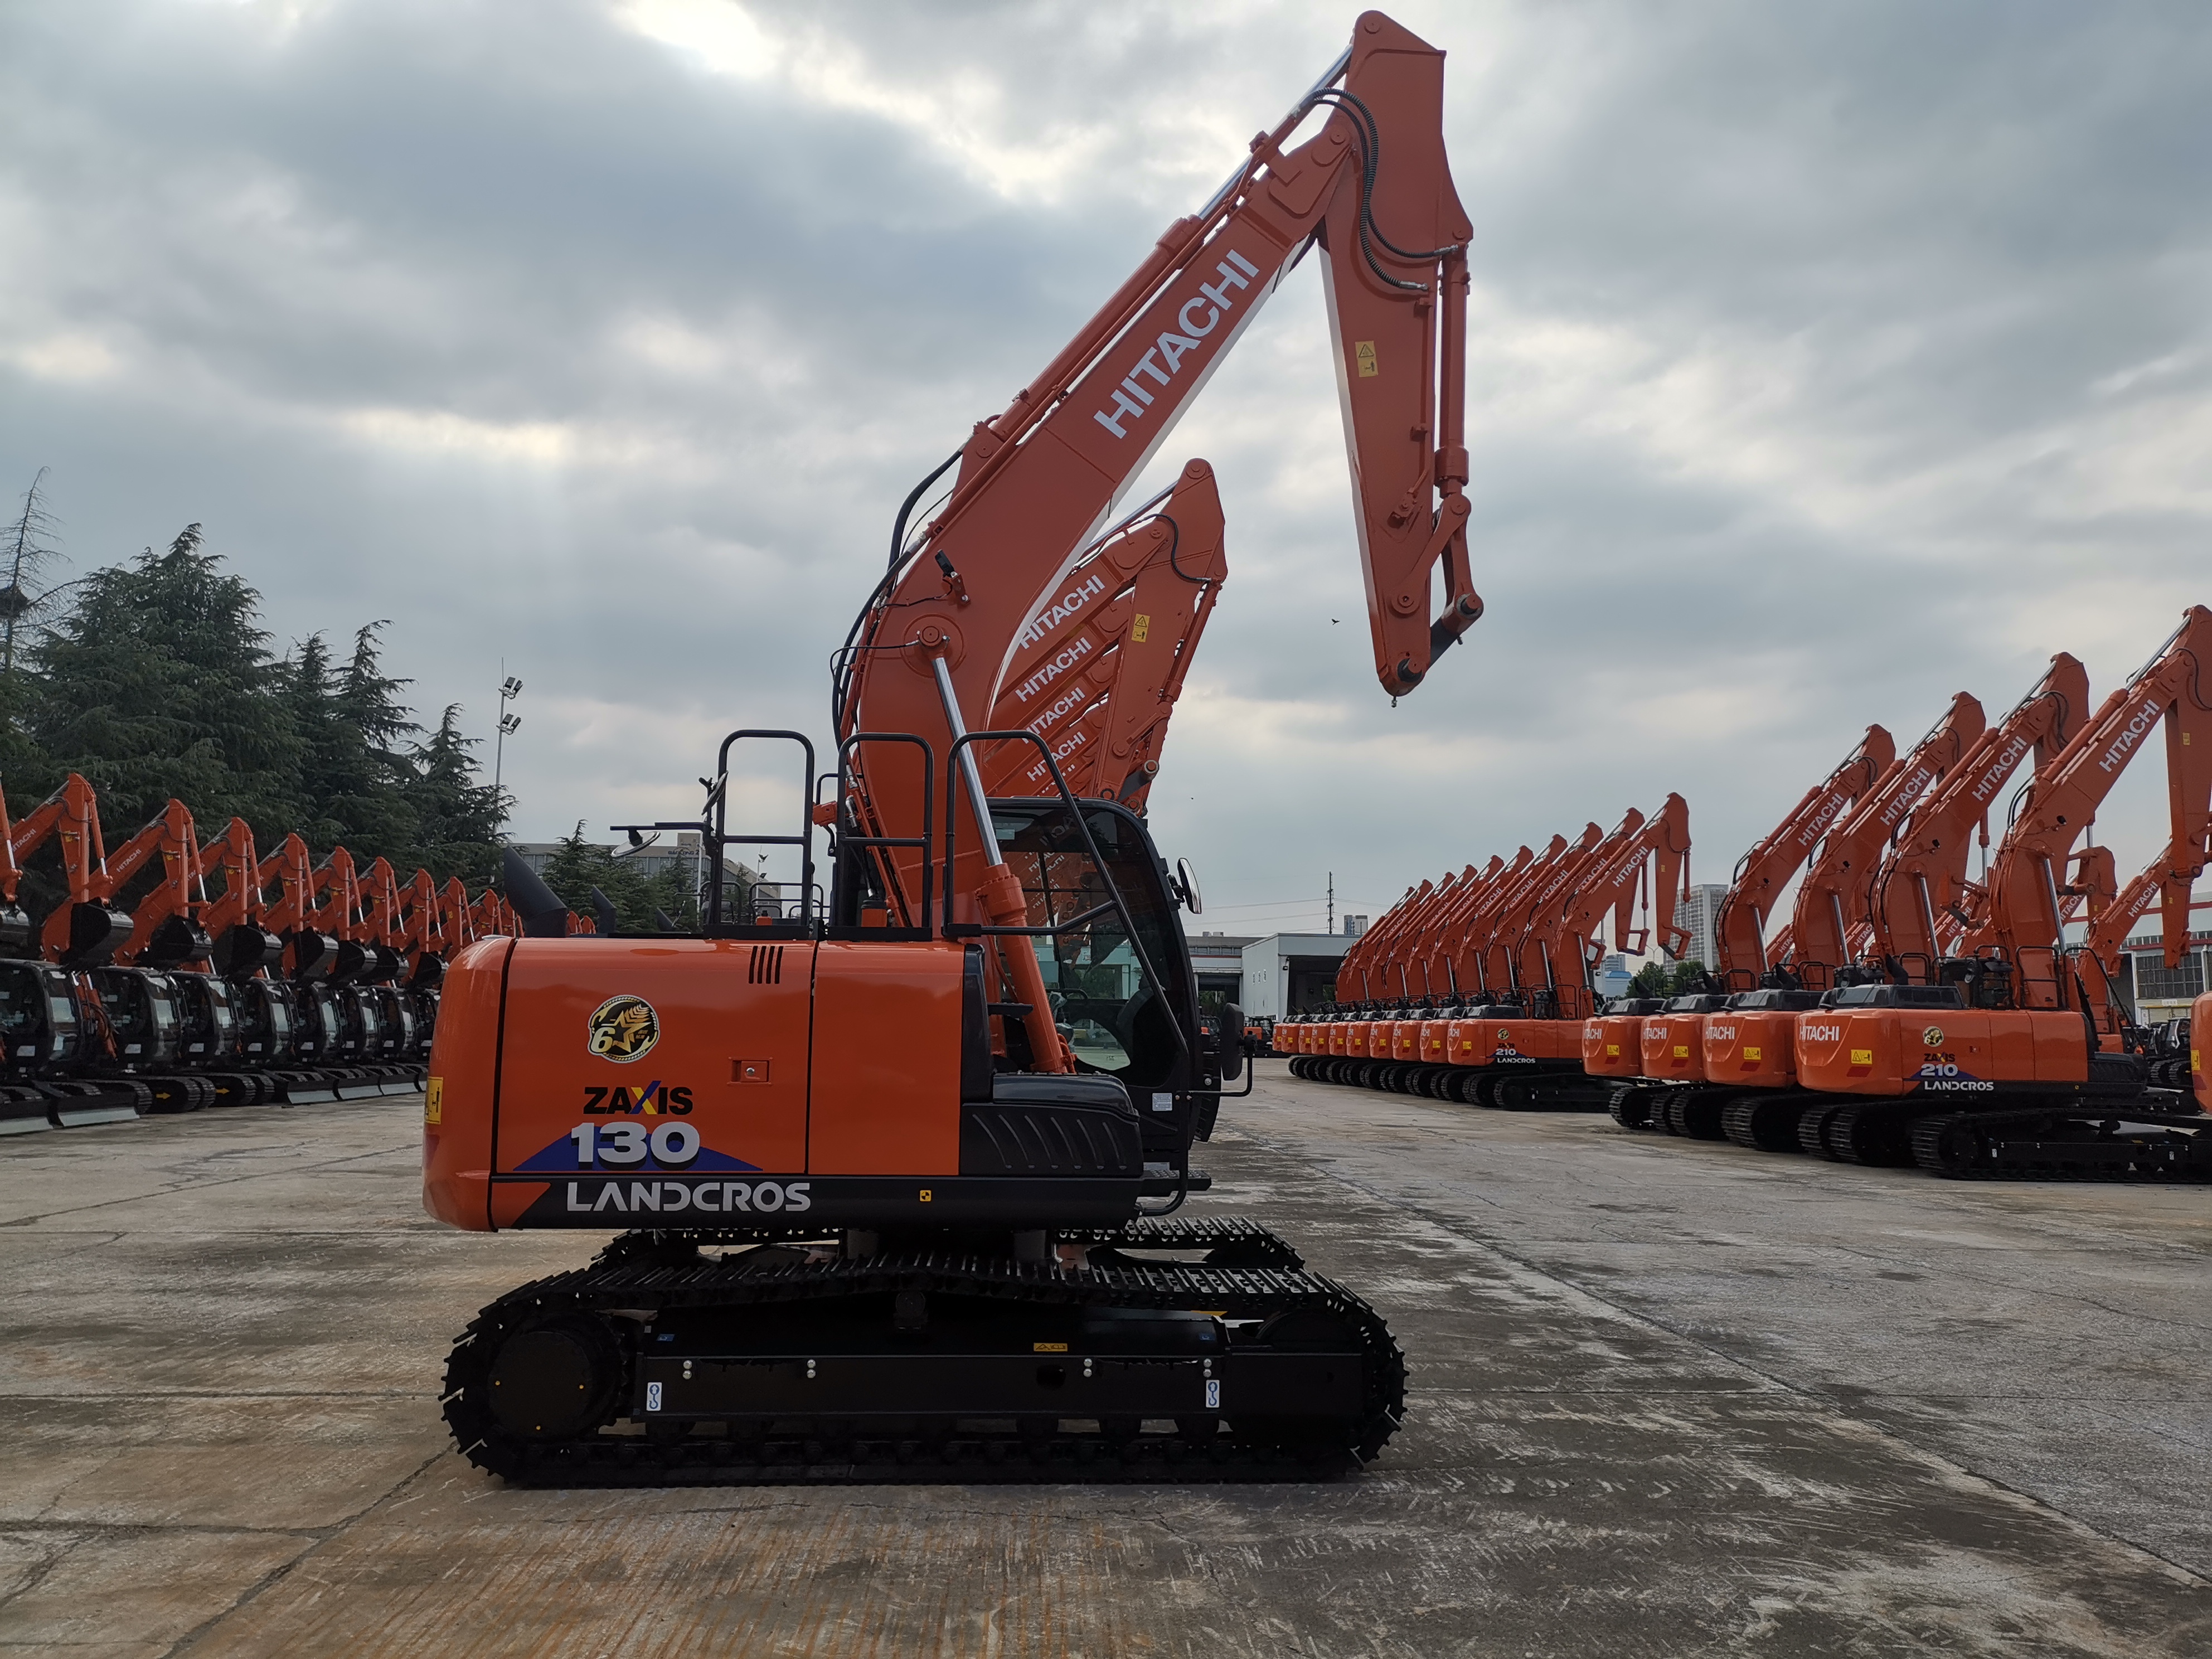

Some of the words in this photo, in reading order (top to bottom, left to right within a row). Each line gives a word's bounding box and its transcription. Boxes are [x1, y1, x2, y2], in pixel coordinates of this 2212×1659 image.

[1093, 249, 1260, 439] HITACHI
[1015, 637, 1093, 702] HITACHI
[2098, 698, 2160, 773] HITACHI
[1026, 731, 1086, 782] HIACHI
[1971, 735, 2027, 802] HITACHI
[1879, 767, 1930, 826] HITACHI
[1797, 793, 1844, 847] HITACHI
[12, 828, 36, 852] ITACHI
[117, 848, 142, 872] HITACHI
[1612, 846, 1648, 887] HITACHI
[2060, 895, 2082, 921] ITACH
[2127, 881, 2159, 918] HITACHI
[1854, 923, 1873, 947] HITAC
[1946, 906, 1972, 938] HITAHI
[1778, 934, 1793, 954] HITAC
[591, 1027, 615, 1053] 6
[1799, 1026, 1839, 1041] HITACHI
[1921, 1063, 1958, 1076] 210
[1924, 1052, 1956, 1063] ZAXIS
[583, 1080, 693, 1115] ZAXIS
[1924, 1081, 1994, 1091] LANDCROS
[571, 1121, 700, 1165] 130
[567, 1181, 811, 1212] LANDCROS
